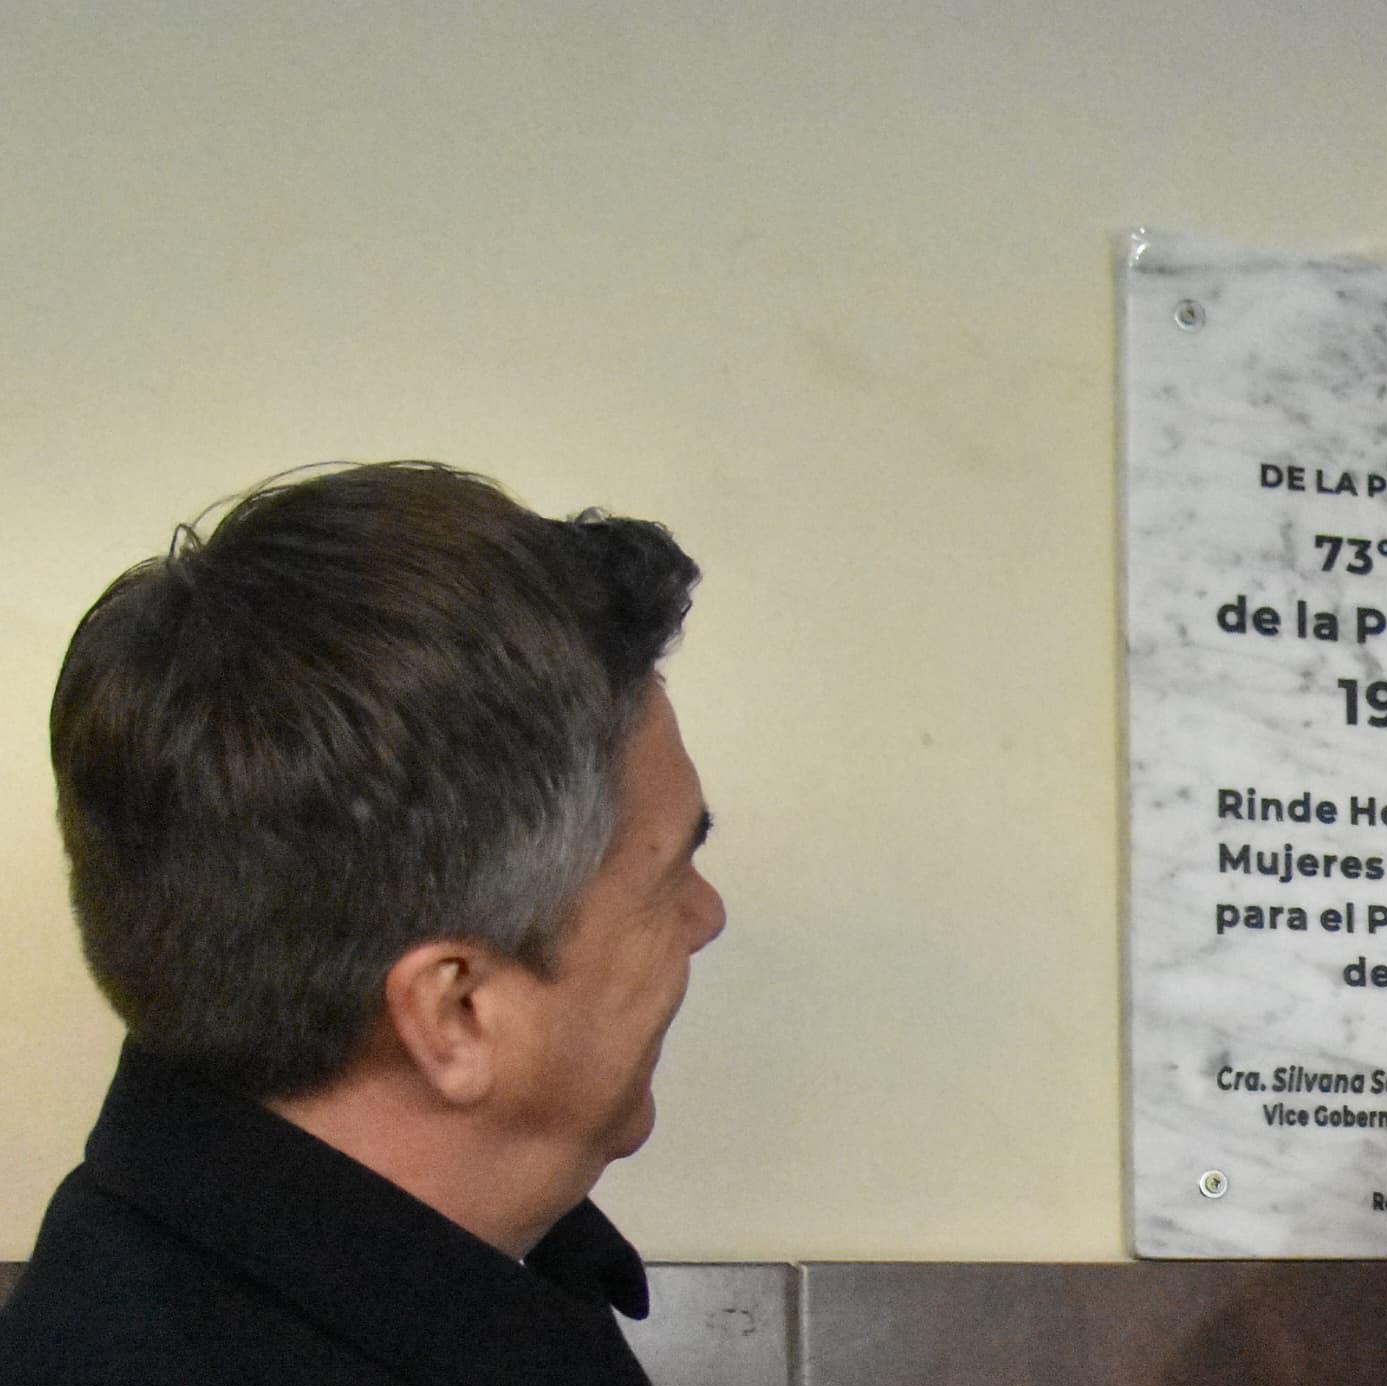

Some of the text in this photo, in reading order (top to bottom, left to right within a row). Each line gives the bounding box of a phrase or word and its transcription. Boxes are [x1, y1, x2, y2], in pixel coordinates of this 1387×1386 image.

[1260, 463, 1306, 492] DE
[1315, 469, 1358, 497] LA
[1216, 594, 1281, 637] de
[1296, 599, 1340, 642] la
[1218, 787, 1338, 825] Rinde
[1219, 843, 1385, 884] Mujeres
[1216, 904, 1307, 935] para
[1319, 902, 1354, 934] el
[1216, 1063, 1267, 1092] Cra.
[1271, 1065, 1365, 1094] Silvana
[1263, 1102, 1310, 1127] Vice
